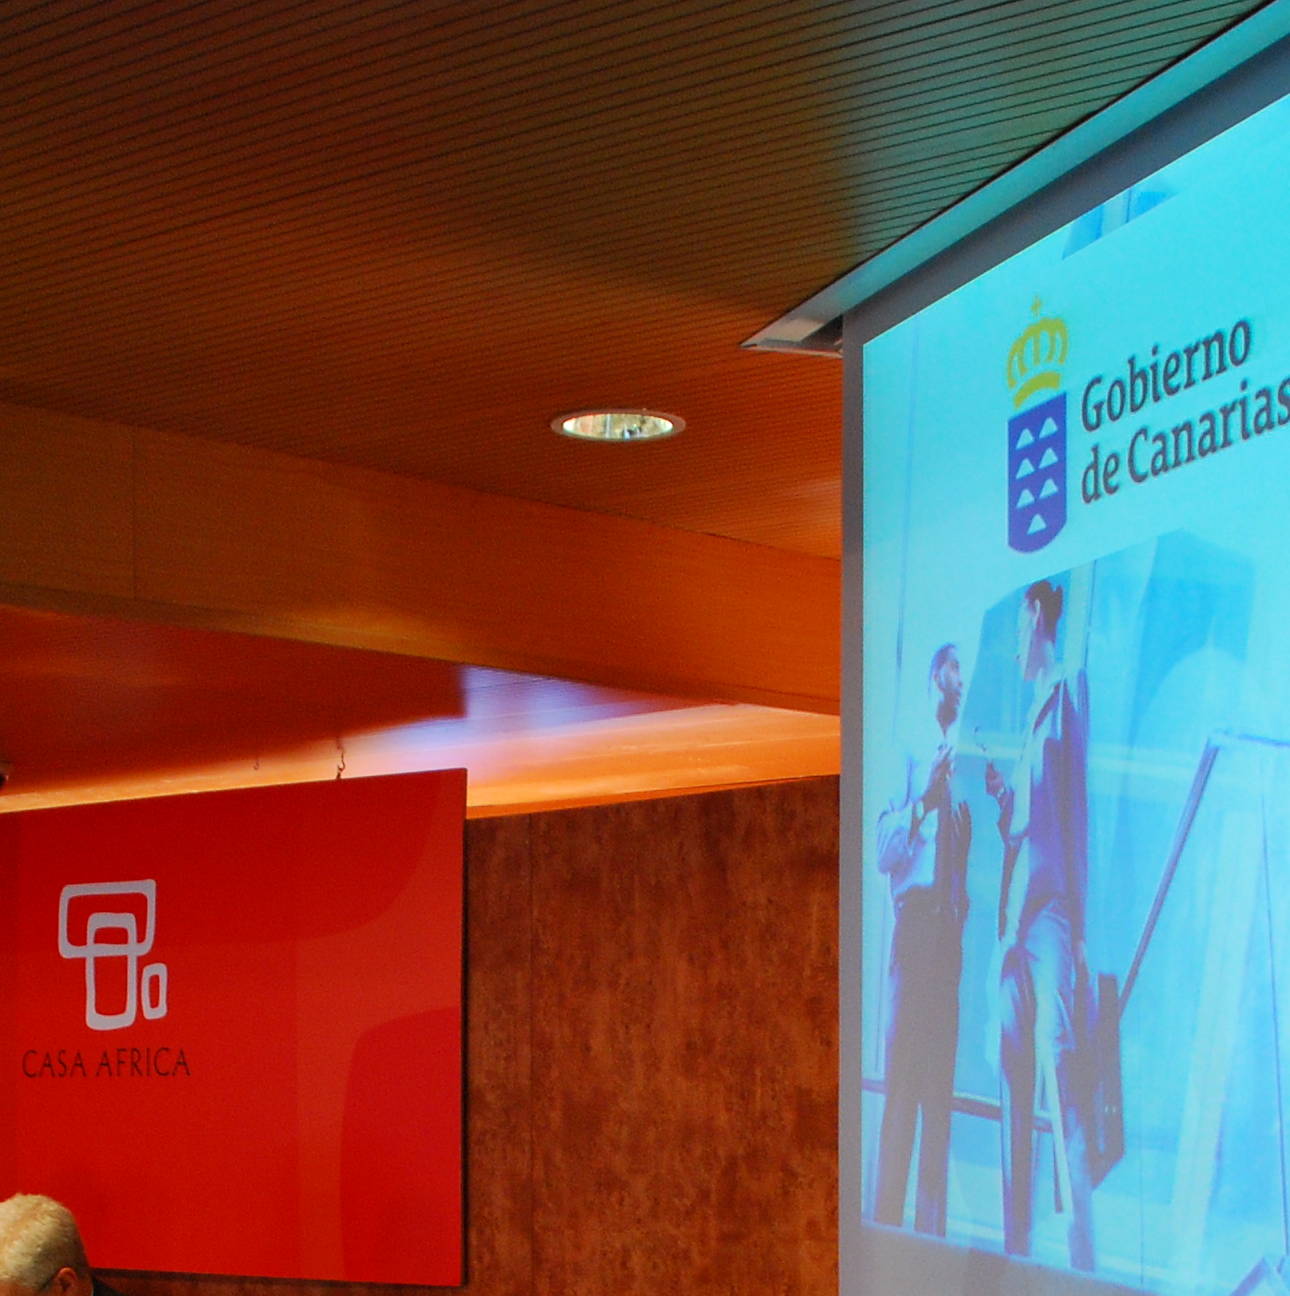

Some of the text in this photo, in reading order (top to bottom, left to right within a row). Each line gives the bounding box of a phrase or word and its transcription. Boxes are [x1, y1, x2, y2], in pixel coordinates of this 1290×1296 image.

[1080, 315, 1253, 433] Gobierno
[1081, 445, 1120, 505] de
[22, 1047, 190, 1079] CASA AFRICA
